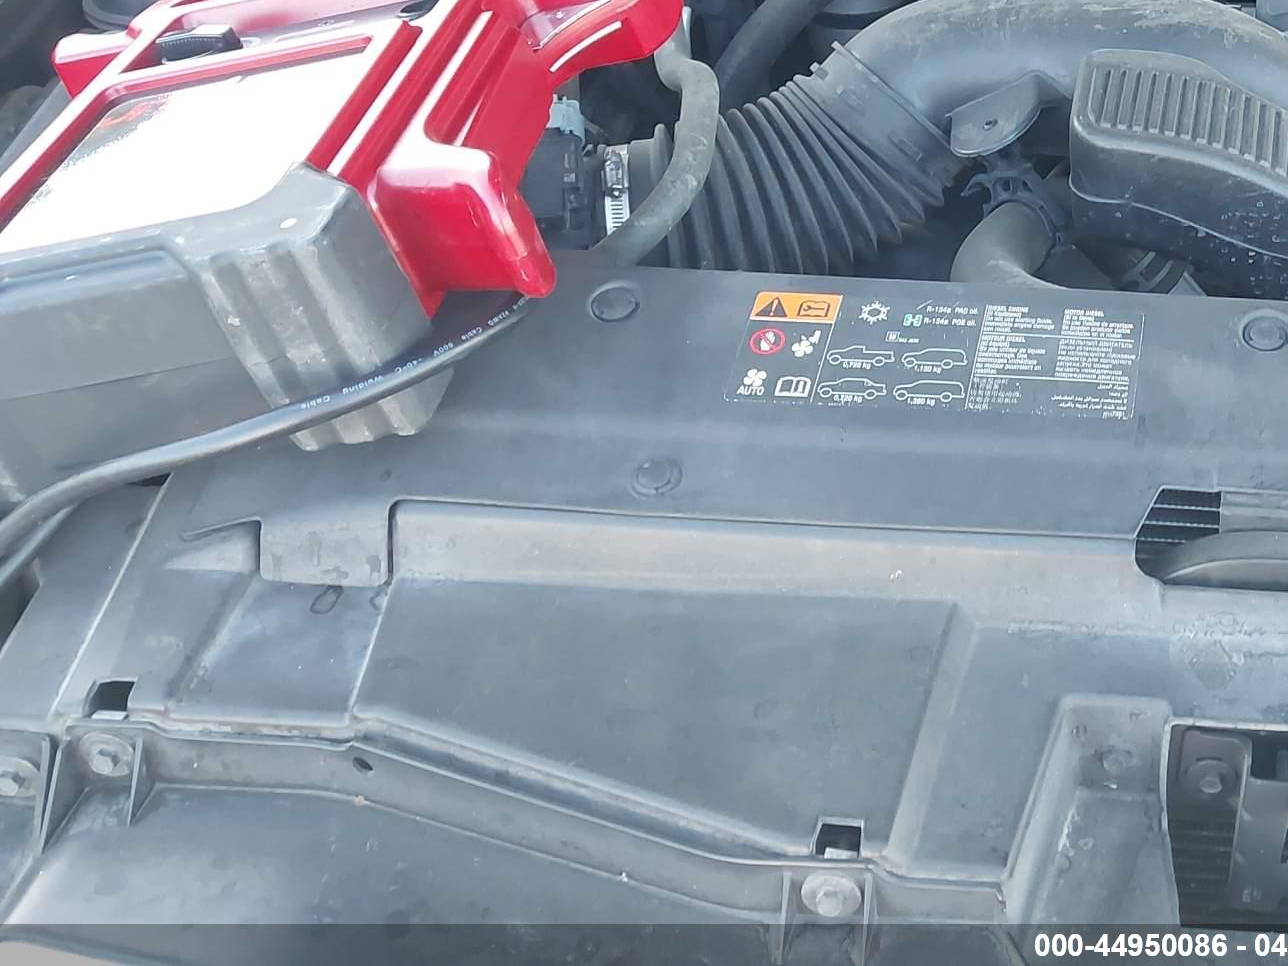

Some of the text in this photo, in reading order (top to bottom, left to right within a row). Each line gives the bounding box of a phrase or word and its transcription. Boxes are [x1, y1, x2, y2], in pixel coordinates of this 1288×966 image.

[461, 326, 483, 341] Cable
[433, 342, 454, 357] 600V
[342, 375, 385, 395] Welding
[736, 385, 765, 396] AUTO
[300, 395, 331, 410] Cable
